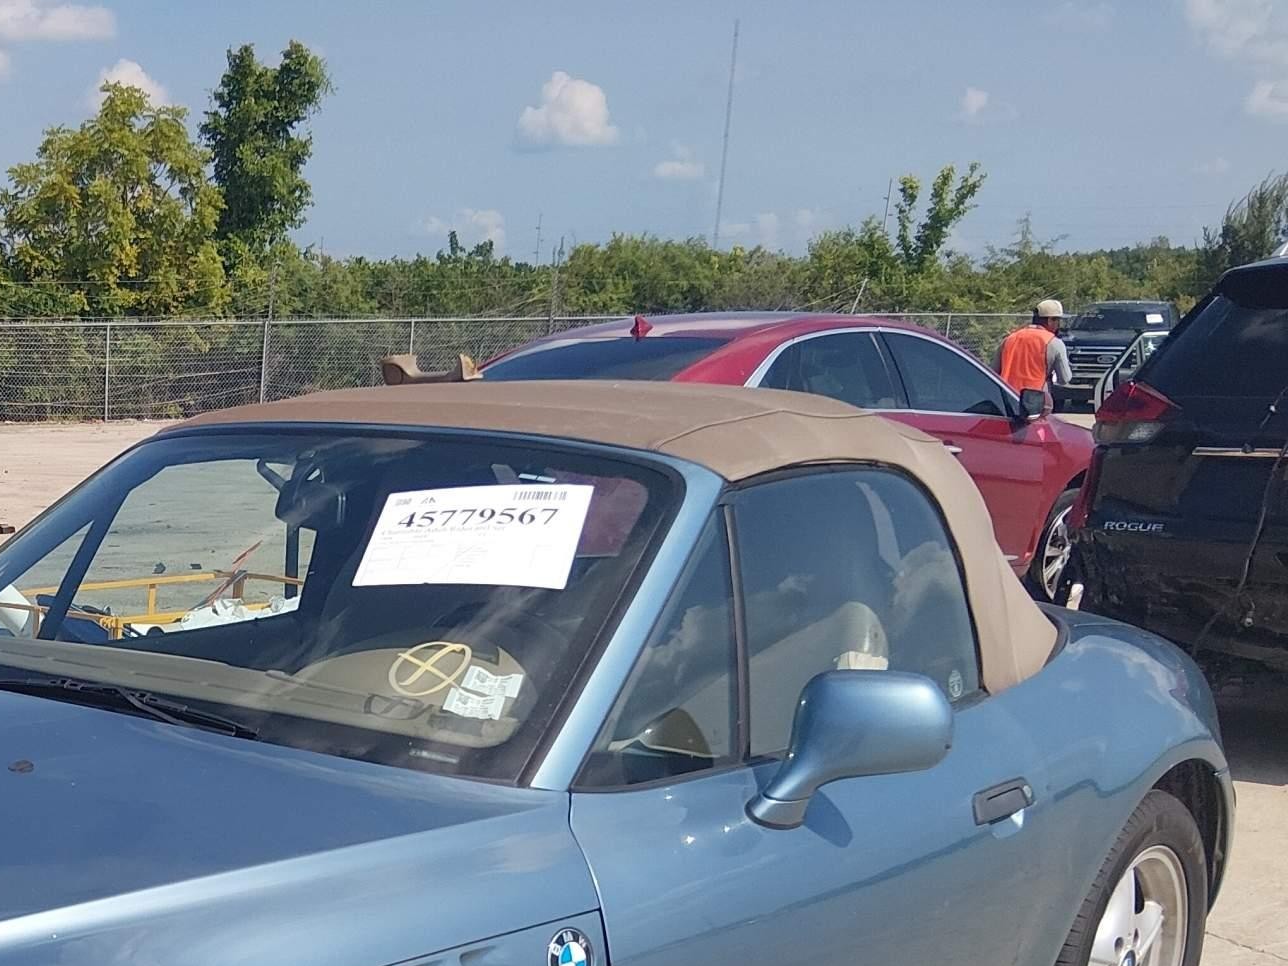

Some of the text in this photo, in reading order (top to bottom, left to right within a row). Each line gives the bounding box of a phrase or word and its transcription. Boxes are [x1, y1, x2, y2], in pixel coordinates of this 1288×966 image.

[397, 507, 559, 528] 45779567
[1104, 521, 1165, 532] ROGUE
[549, 930, 587, 957] BMW
